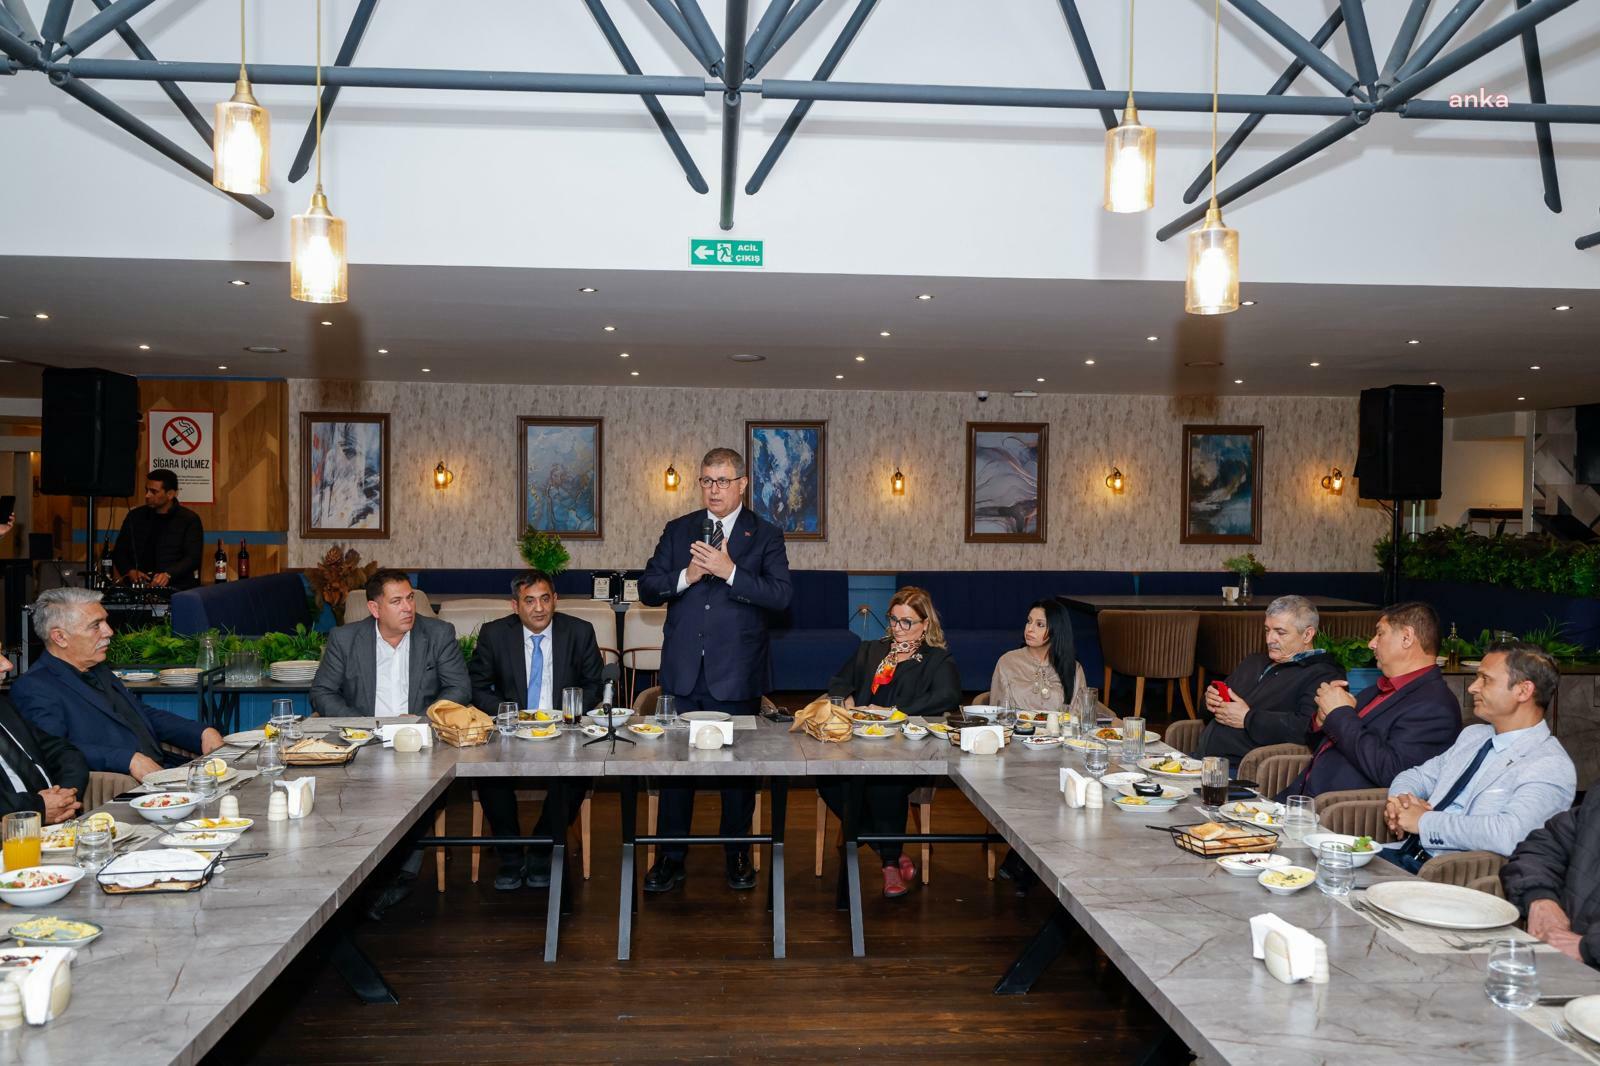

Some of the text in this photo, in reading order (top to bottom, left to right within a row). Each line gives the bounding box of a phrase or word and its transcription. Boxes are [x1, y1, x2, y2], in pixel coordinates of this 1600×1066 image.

[737, 243, 759, 252] ACİL
[735, 254, 761, 263] ÇIKIŞ
[153, 458, 210, 470] SİGARA İÇİLMEZ
